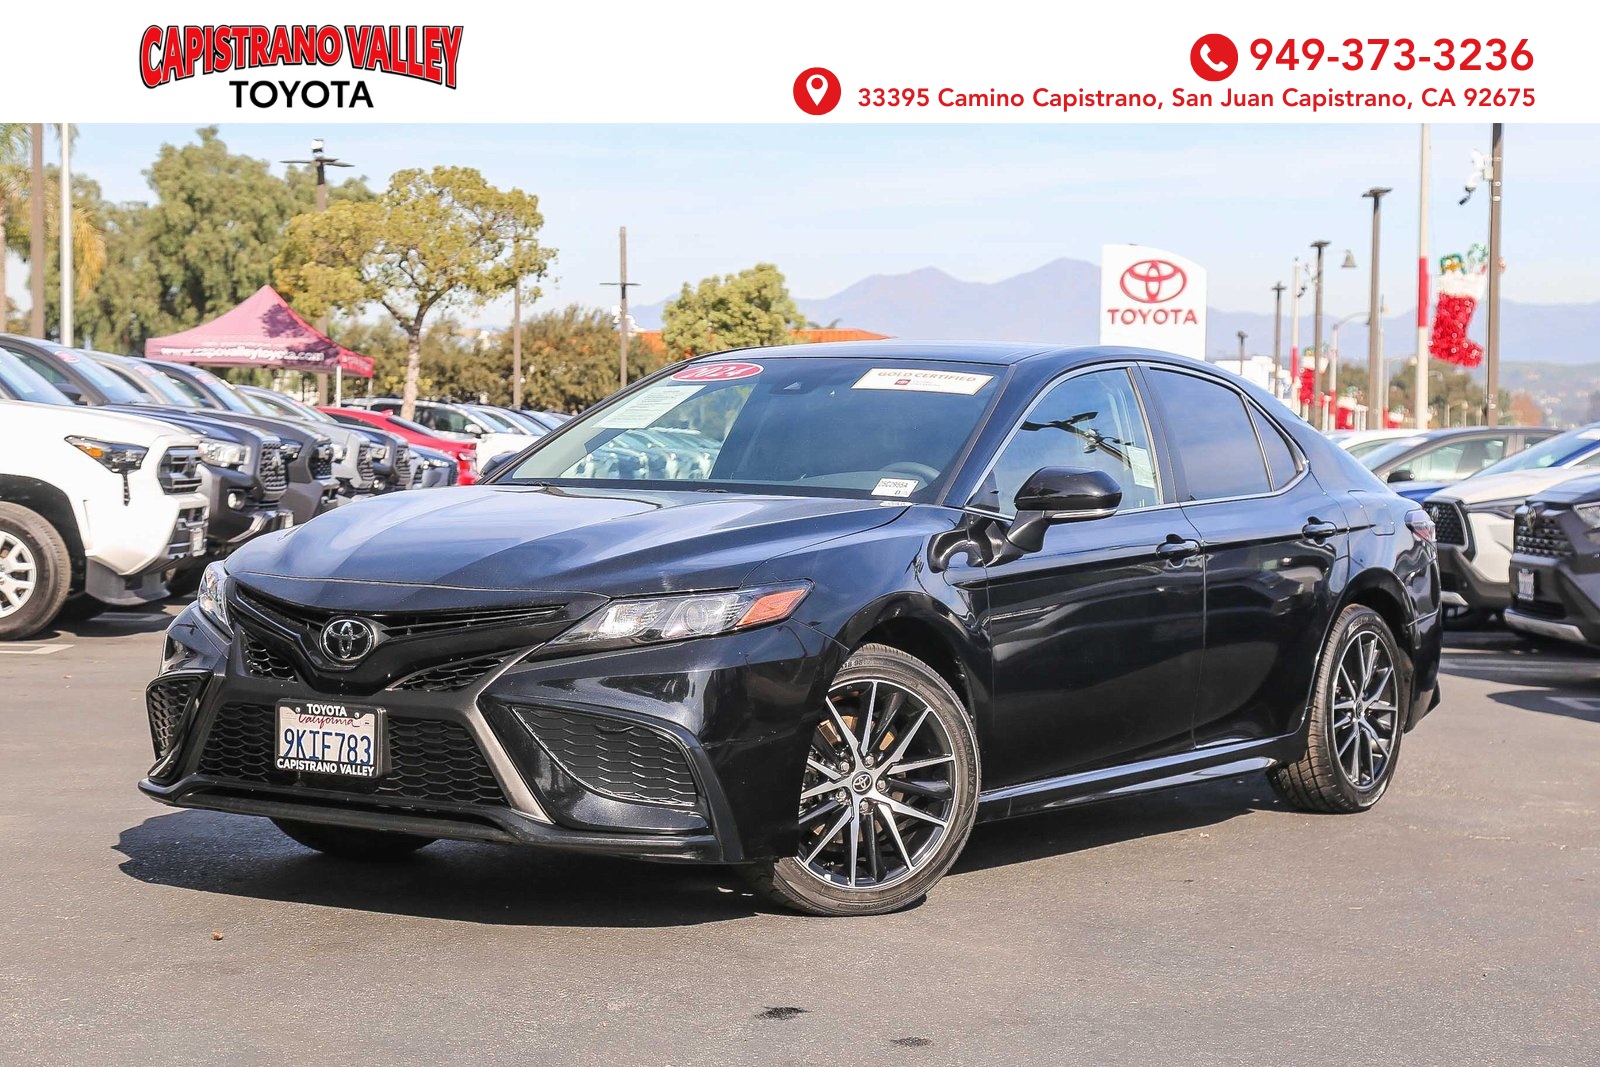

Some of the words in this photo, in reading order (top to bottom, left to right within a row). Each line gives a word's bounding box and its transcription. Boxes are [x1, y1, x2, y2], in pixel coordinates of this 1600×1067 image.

[1107, 309, 1198, 325] TOYOTA
[914, 372, 977, 382] CERTIFIED
[306, 703, 348, 717] TOYOTA
[283, 727, 372, 766] 9KIF783
[276, 758, 337, 774] CAPISTRANO
[340, 763, 375, 777] VALLEY
